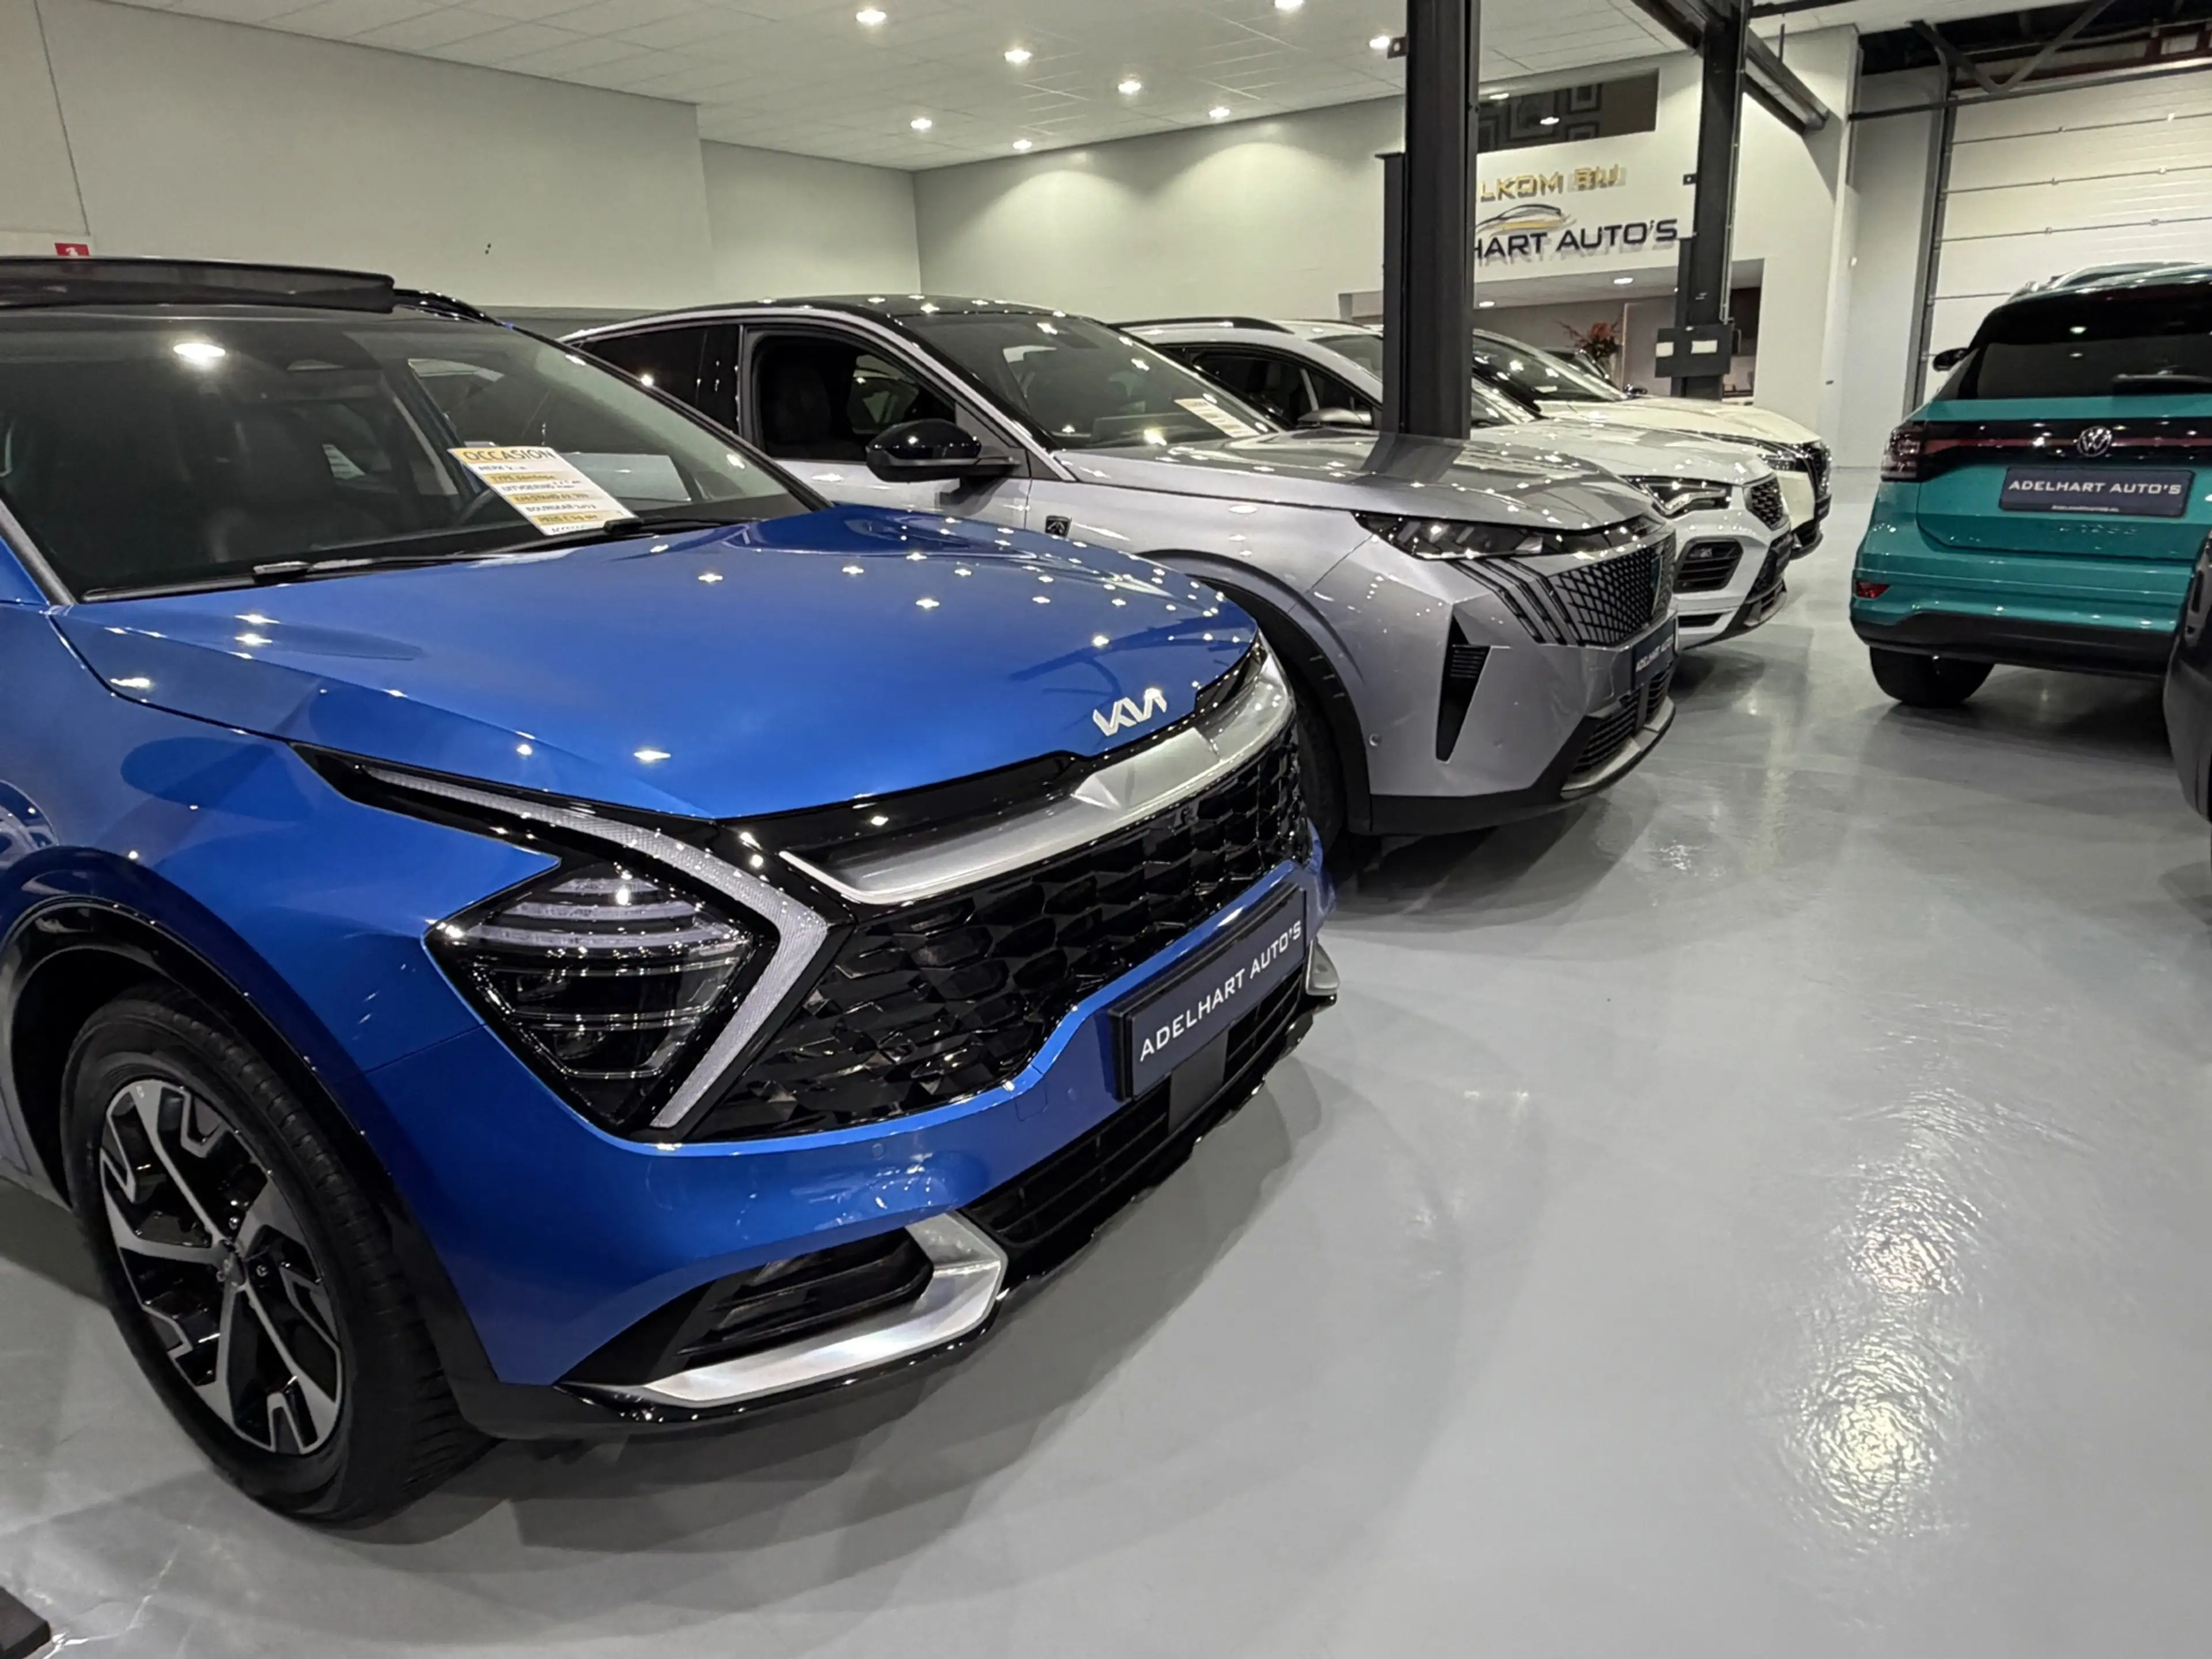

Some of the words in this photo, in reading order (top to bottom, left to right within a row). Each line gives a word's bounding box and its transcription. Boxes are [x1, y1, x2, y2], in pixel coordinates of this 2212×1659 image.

[1480, 172, 1563, 202] LKOM
[1474, 232, 1548, 259] HART
[1556, 218, 1678, 252] AUTO'S
[463, 449, 557, 461] OCCASION
[2008, 480, 2106, 493] ADELHART
[2109, 483, 2182, 495] AUTO'S
[1139, 968, 1245, 1062] ADELHART
[1249, 920, 1301, 979] AUTO'S
